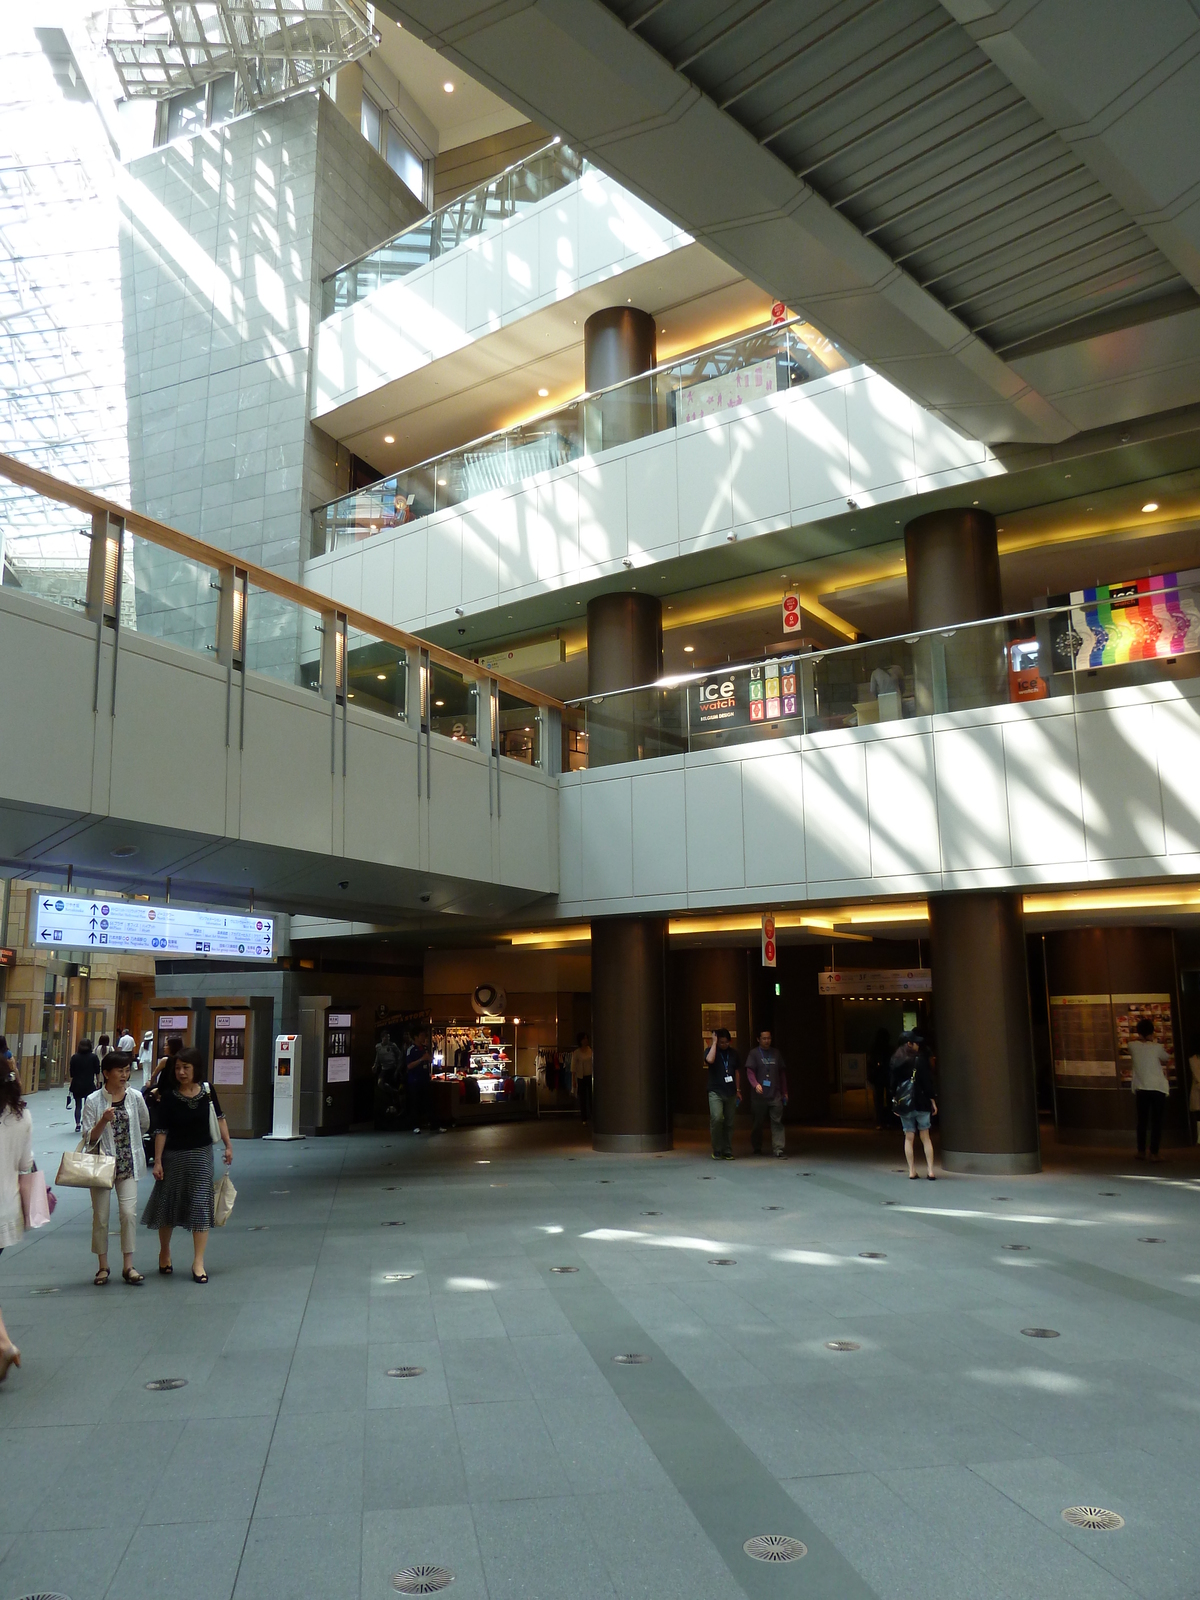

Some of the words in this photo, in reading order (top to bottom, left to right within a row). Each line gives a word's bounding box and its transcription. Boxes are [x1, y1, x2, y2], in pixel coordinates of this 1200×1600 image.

[1018, 678, 1037, 690] ice
[699, 682, 735, 702] ice
[700, 698, 735, 712] watch
